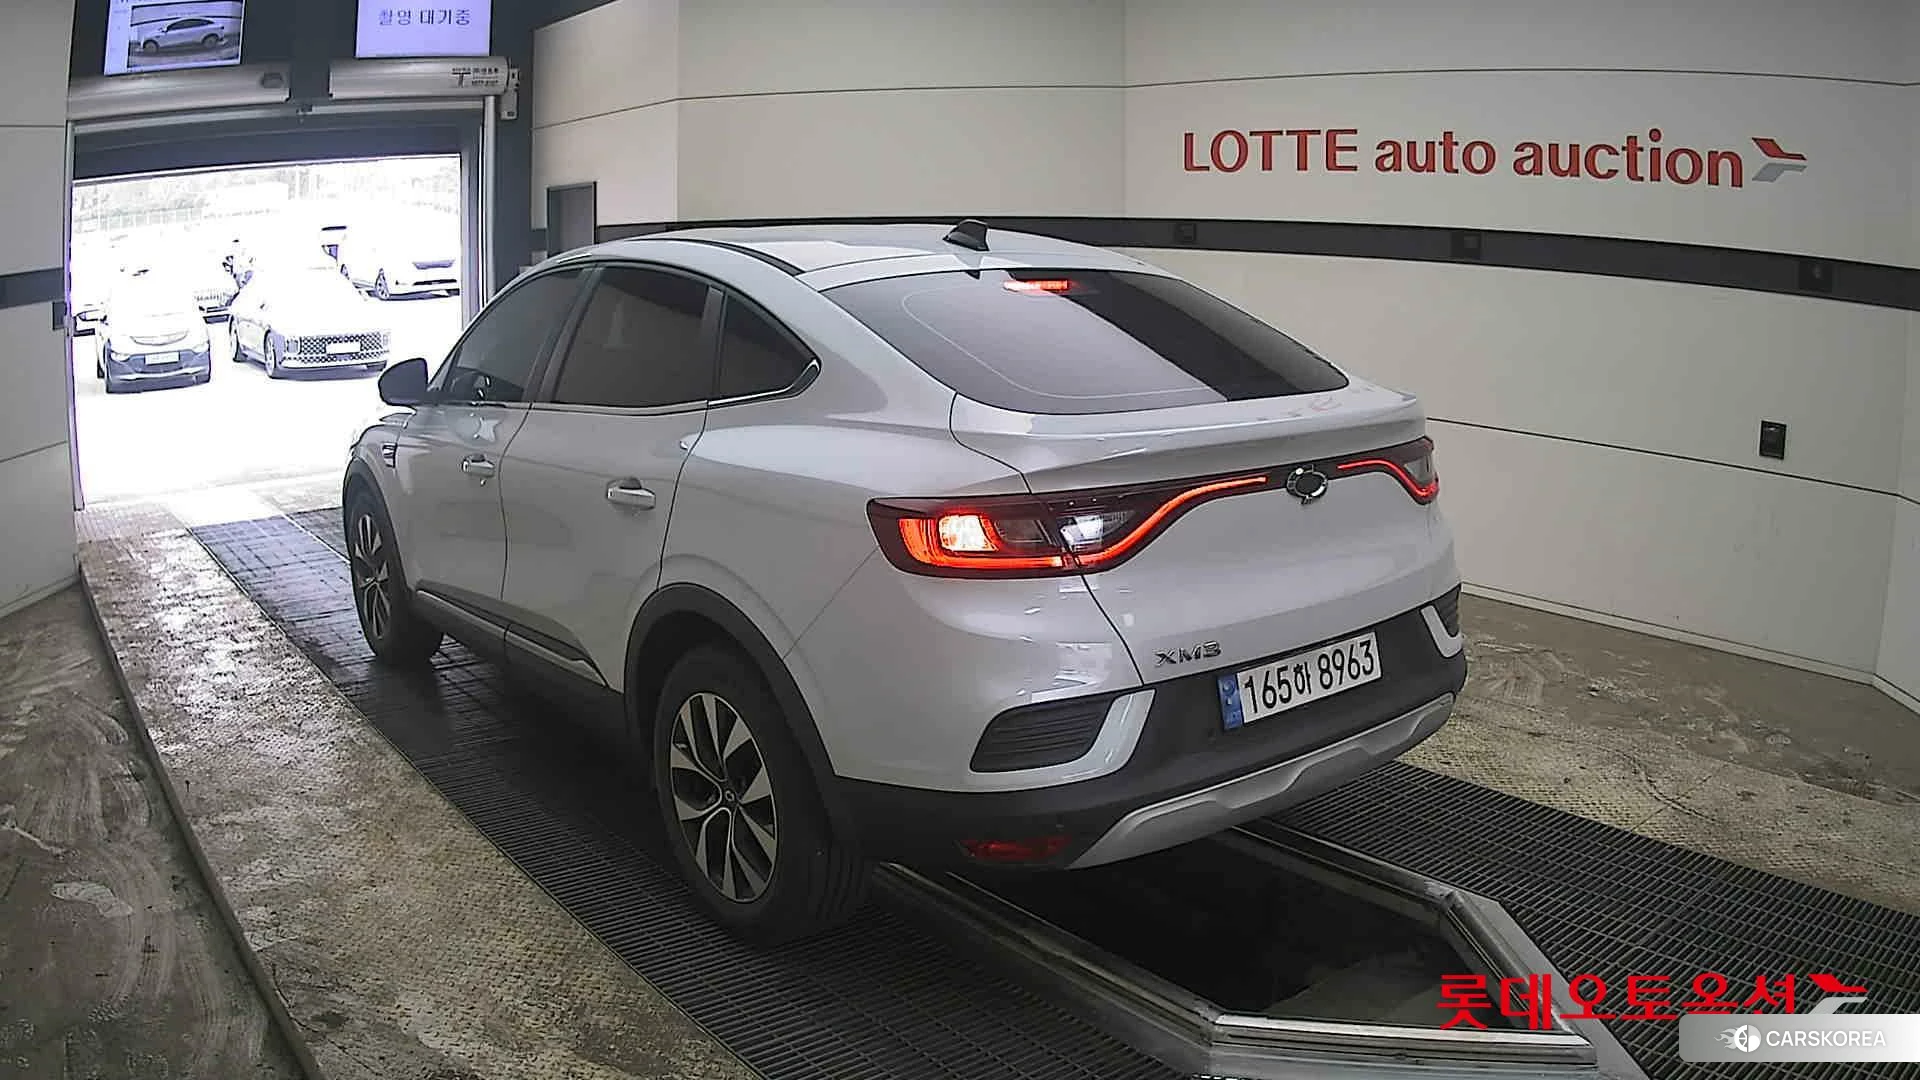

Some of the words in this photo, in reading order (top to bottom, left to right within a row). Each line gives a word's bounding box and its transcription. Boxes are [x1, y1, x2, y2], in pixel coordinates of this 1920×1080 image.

[419, 9, 470, 26] 대기중
[1183, 129, 1358, 172] LOTTE
[1375, 131, 1496, 174] auto
[1513, 128, 1743, 188] auction
[1155, 640, 1222, 667] XM3
[1244, 661, 1312, 714] 165하
[1318, 639, 1375, 690] 8963
